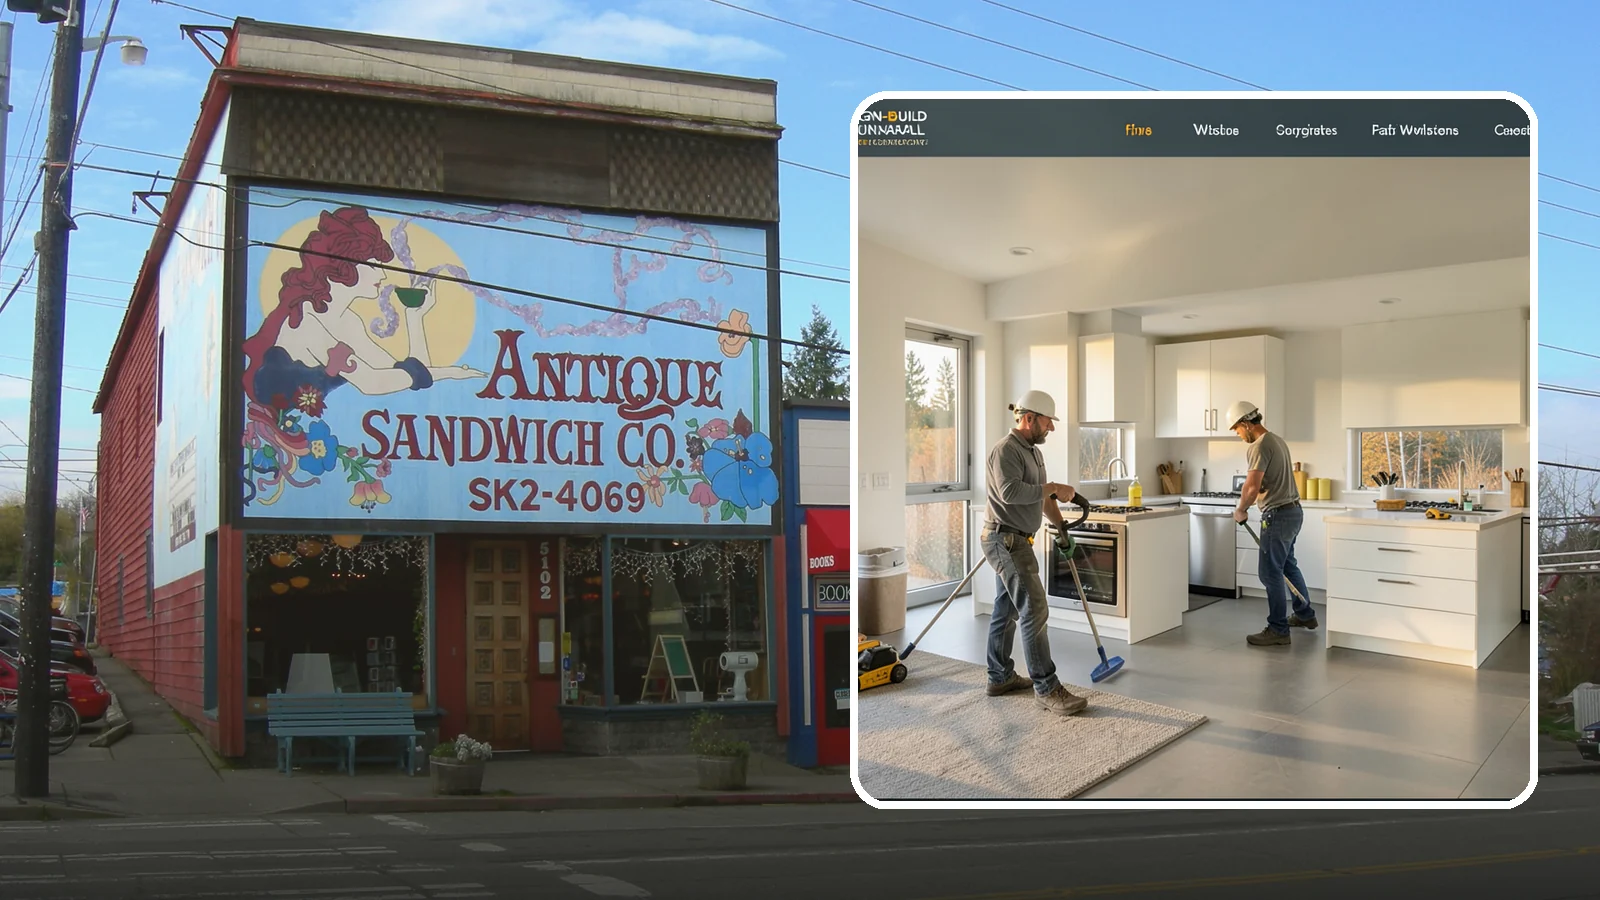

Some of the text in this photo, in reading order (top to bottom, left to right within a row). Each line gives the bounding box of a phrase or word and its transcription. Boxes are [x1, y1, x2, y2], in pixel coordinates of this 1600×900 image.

[476, 328, 724, 421] ANTIQUE
[361, 408, 685, 468] SANDWICH CO.
[468, 477, 646, 513] SK2-4069
[539, 542, 552, 600] 5102
[809, 555, 835, 569] BOOKS
